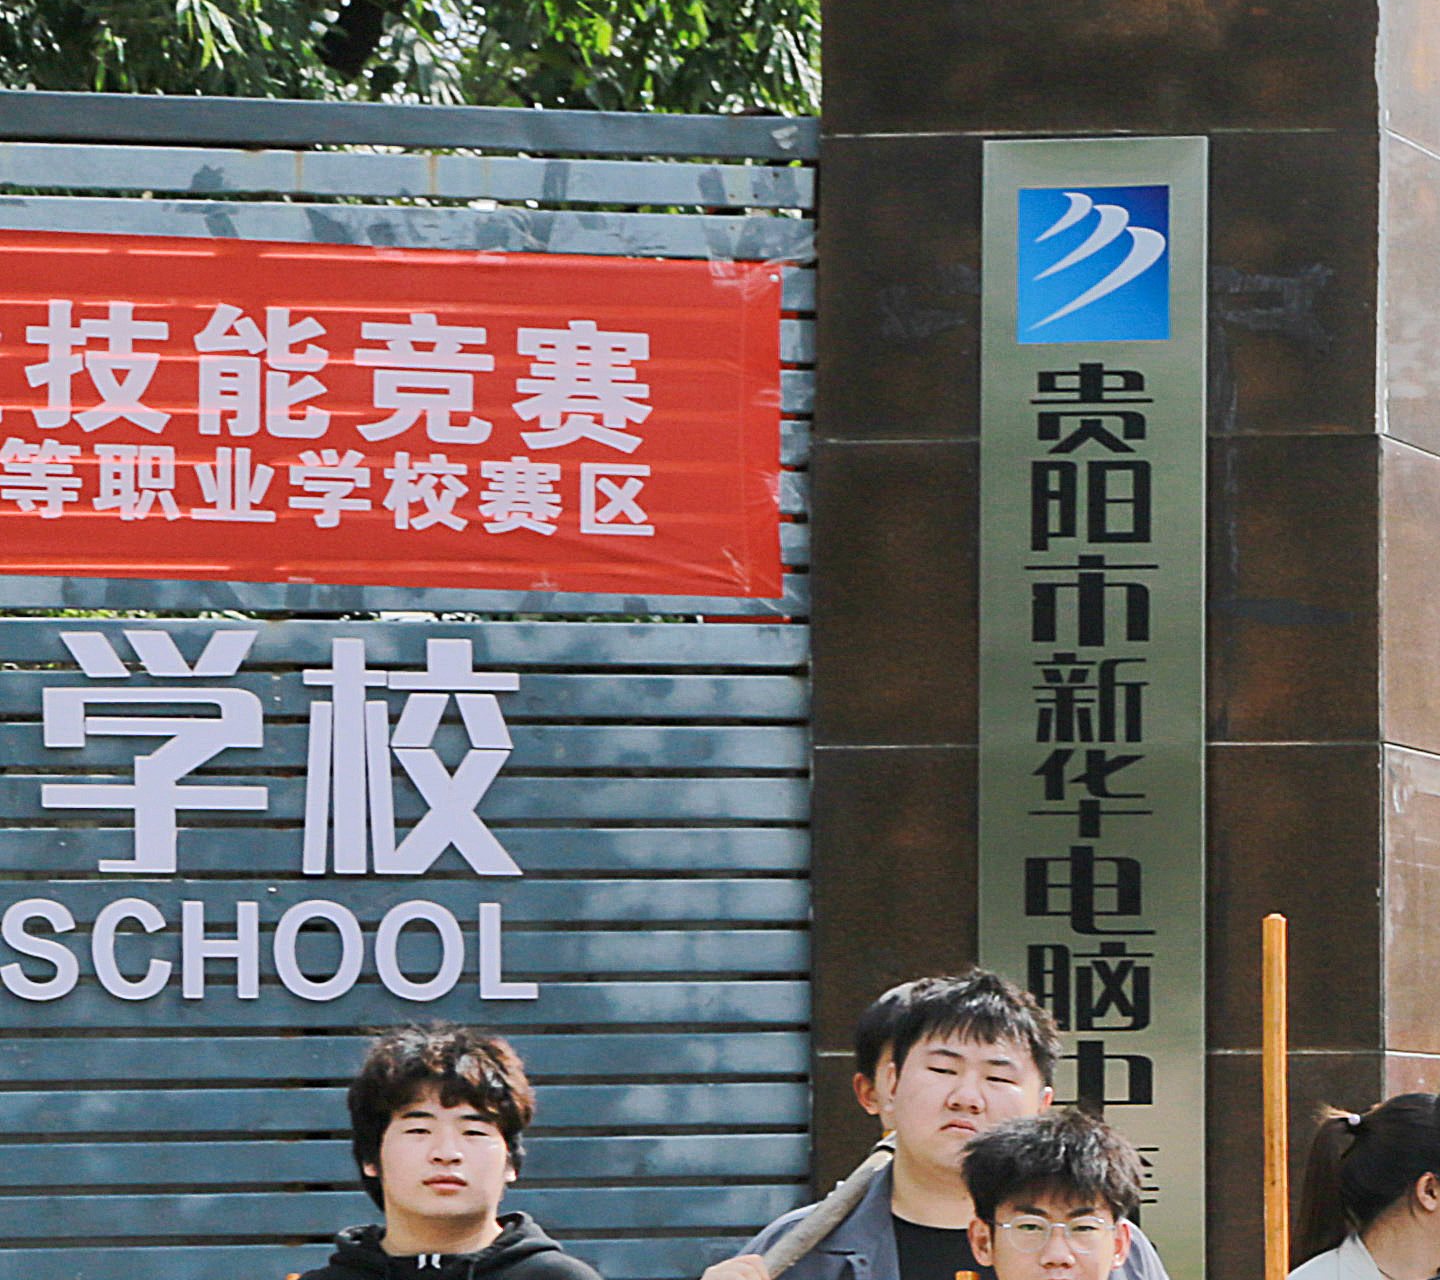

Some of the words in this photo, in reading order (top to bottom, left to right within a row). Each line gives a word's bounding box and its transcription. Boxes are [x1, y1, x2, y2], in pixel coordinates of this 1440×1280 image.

[24, 299, 654, 453] 技能竞赛
[0, 437, 656, 537] 等职业学校赛区
[41, 629, 522, 876] 学校
[0, 898, 539, 1003] SCHOOL
